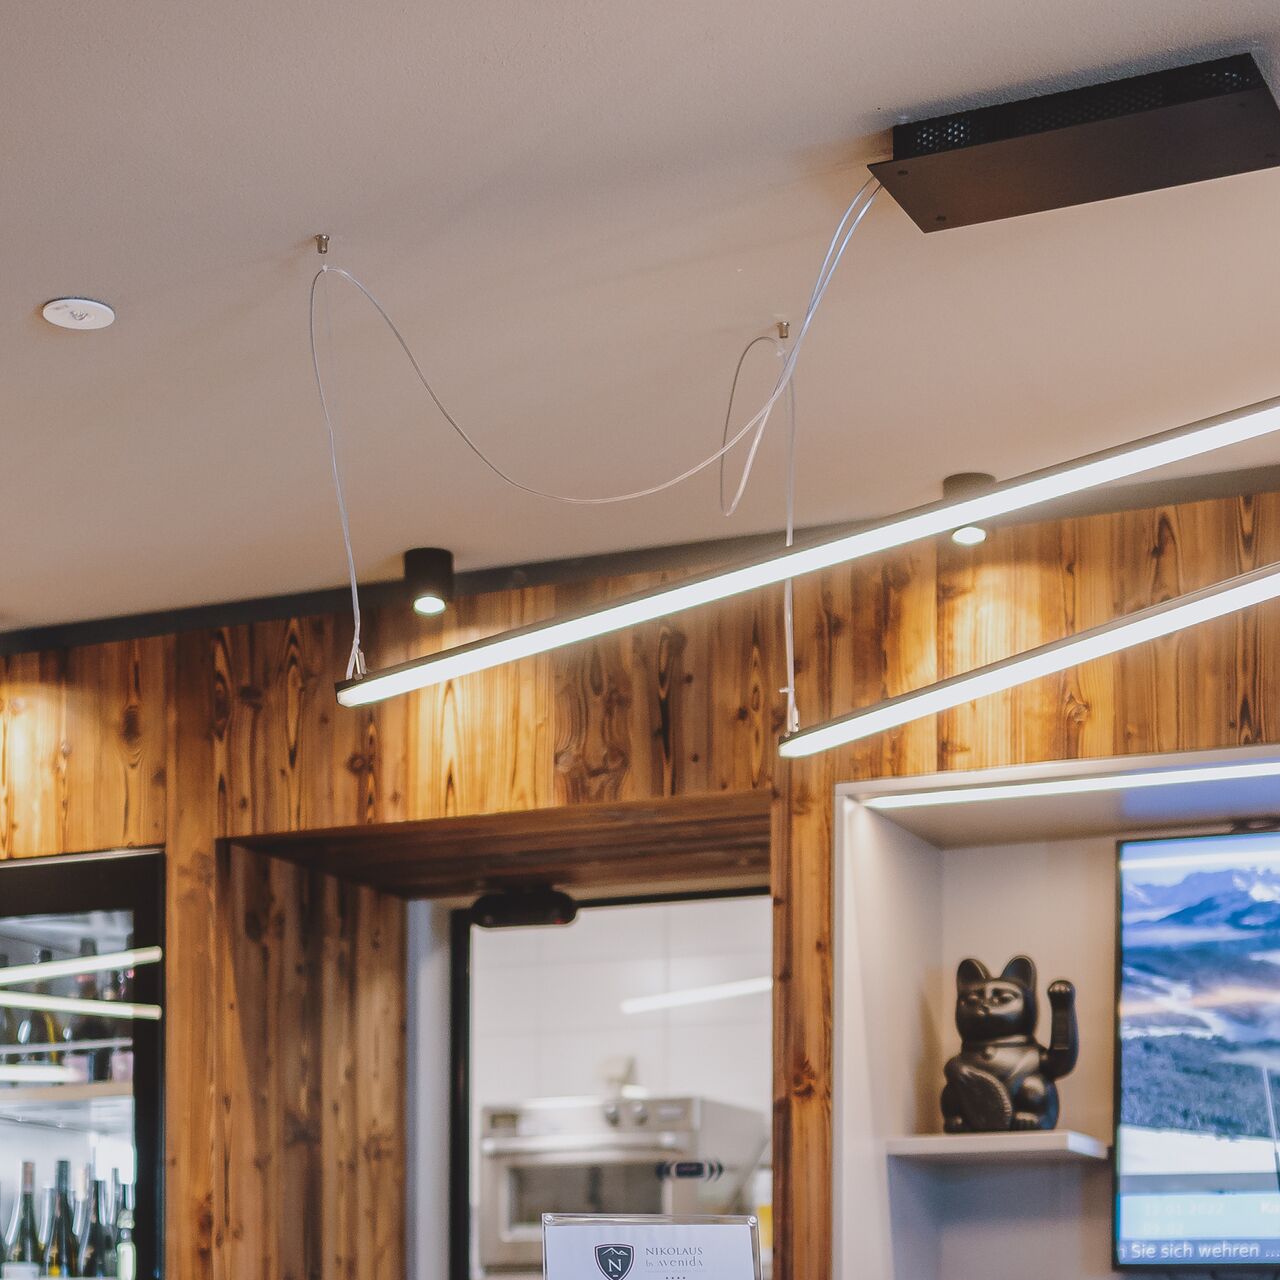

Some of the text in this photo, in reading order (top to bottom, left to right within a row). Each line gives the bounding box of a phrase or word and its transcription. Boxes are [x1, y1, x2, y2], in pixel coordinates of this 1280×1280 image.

[645, 1247, 703, 1256] NIKOLAUS
[1131, 1240, 1156, 1258] Sie
[1160, 1240, 1193, 1258] sich
[1198, 1239, 1260, 1258] wehren
[607, 1258, 622, 1273] N
